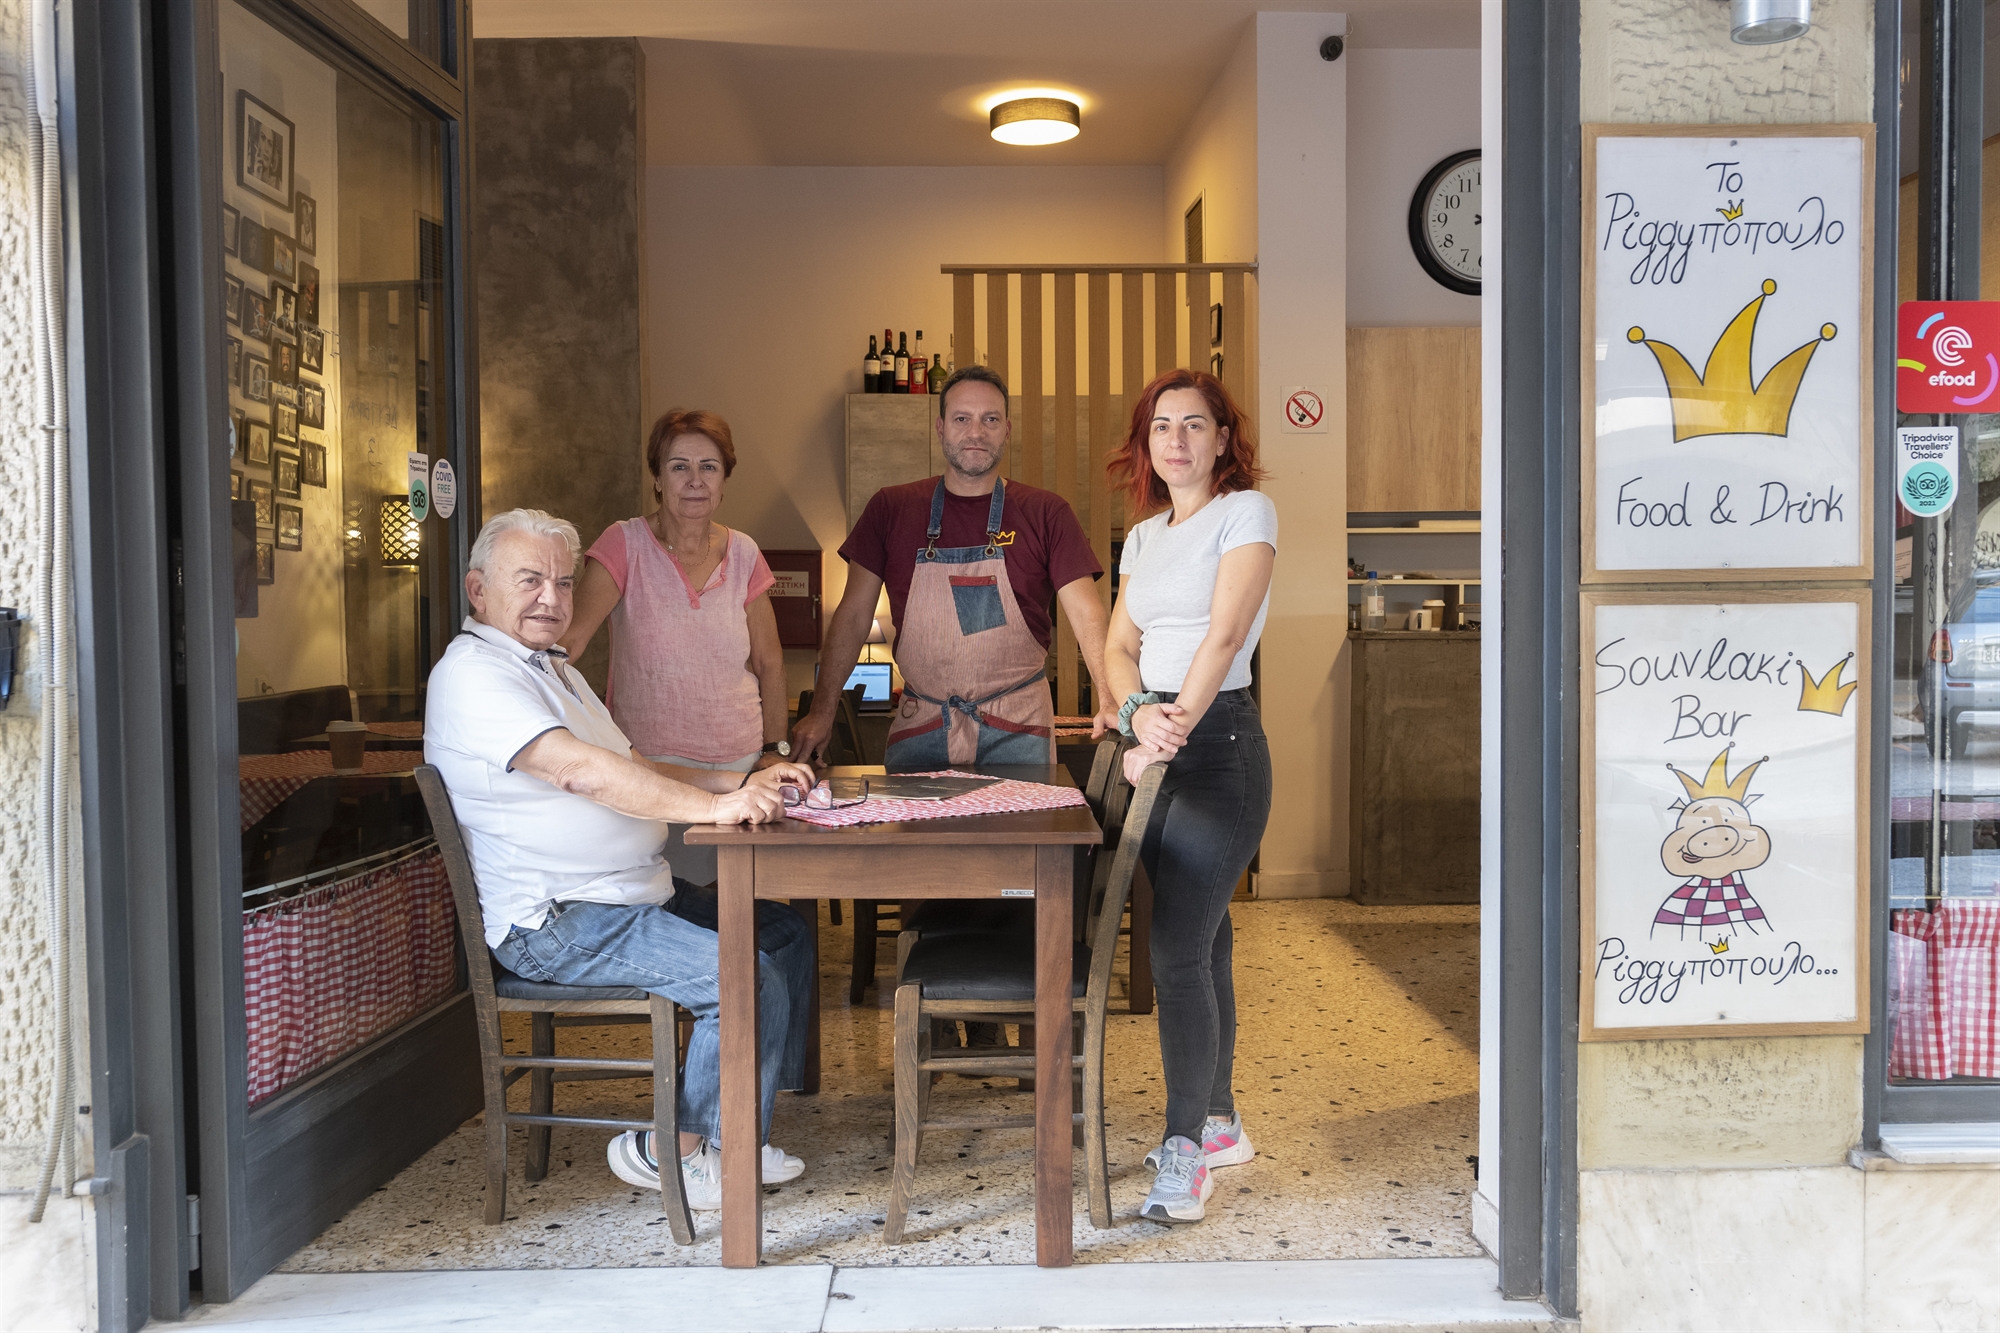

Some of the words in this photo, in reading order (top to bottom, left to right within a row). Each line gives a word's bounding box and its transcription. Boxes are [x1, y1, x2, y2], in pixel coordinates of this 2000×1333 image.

[1459, 178, 1473, 193] 11
[1444, 194, 1461, 210] 10
[1437, 212, 1448, 228] 9
[1443, 233, 1454, 248] 8
[1460, 248, 1470, 263] 7
[1928, 370, 1976, 387] efood
[1902, 433, 1954, 444] Tripadvisor
[1911, 451, 1944, 460] Choice
[436, 471, 452, 482] COVID
[437, 483, 451, 494] FREE
[1617, 477, 1692, 527] Food
[1710, 485, 1738, 524] &
[1750, 481, 1843, 526] Drink
[1594, 637, 1794, 696] Souvlaki
[1663, 694, 1752, 743] Bar
